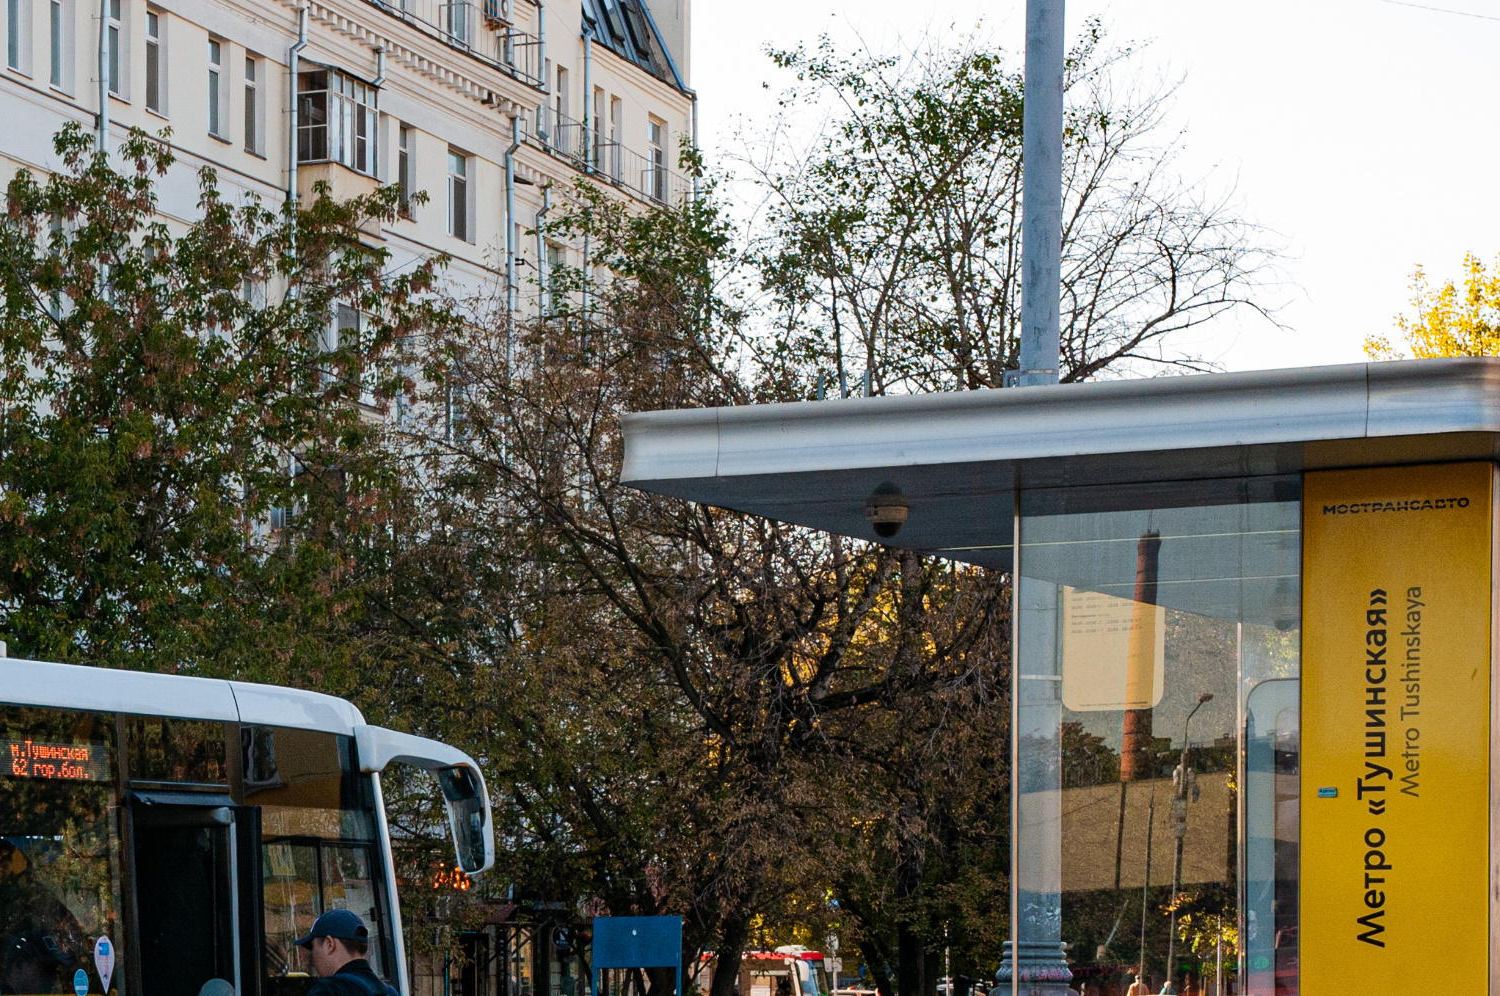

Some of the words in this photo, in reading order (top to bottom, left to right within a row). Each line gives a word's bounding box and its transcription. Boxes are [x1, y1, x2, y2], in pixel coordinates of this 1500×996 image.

[1322, 497, 1470, 515] МОСТРАНСАВТО
[1400, 586, 1426, 721] Tushinskaya
[1357, 588, 1393, 816] «Тушинская»
[12, 758, 28, 776] 62
[1400, 727, 1420, 798] Metro
[1356, 828, 1393, 948] Метро
